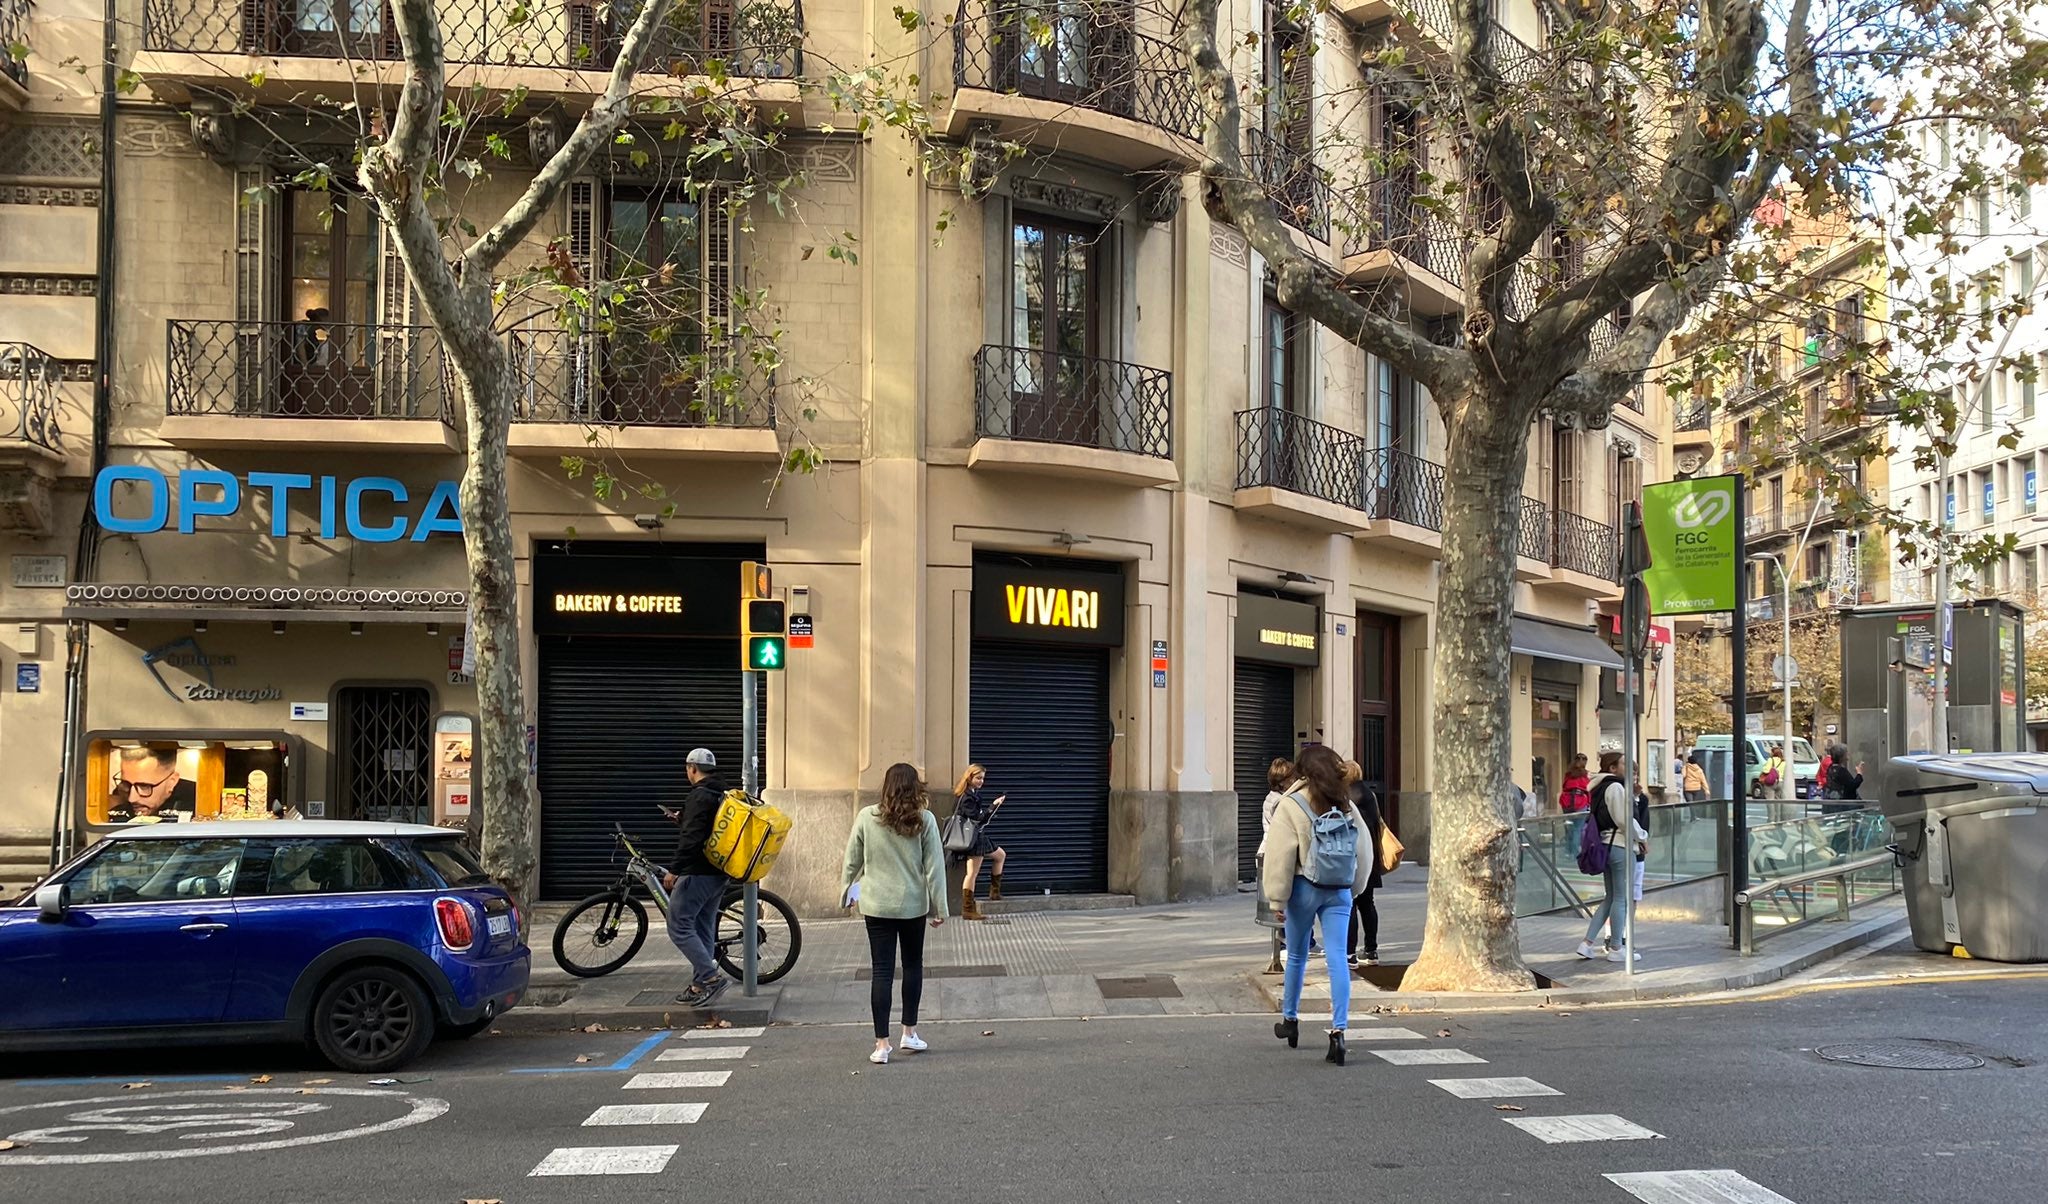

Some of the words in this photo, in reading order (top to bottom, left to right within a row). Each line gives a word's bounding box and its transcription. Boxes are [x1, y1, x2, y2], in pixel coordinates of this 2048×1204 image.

[94, 464, 463, 542] OPTICA
[1675, 531, 1708, 546] FGC
[555, 594, 612, 612] BAKERY
[615, 594, 627, 612] &
[629, 595, 682, 613] COFFEE
[1006, 584, 1098, 628] VIVARI
[1663, 598, 1715, 609] Provença
[1909, 625, 1926, 633] FGC
[1944, 607, 1951, 642] P
[1260, 629, 1286, 645] BAKERY
[1286, 632, 1292, 646] &
[1292, 633, 1315, 650] COFFEE
[185, 683, 282, 705] Tarragón
